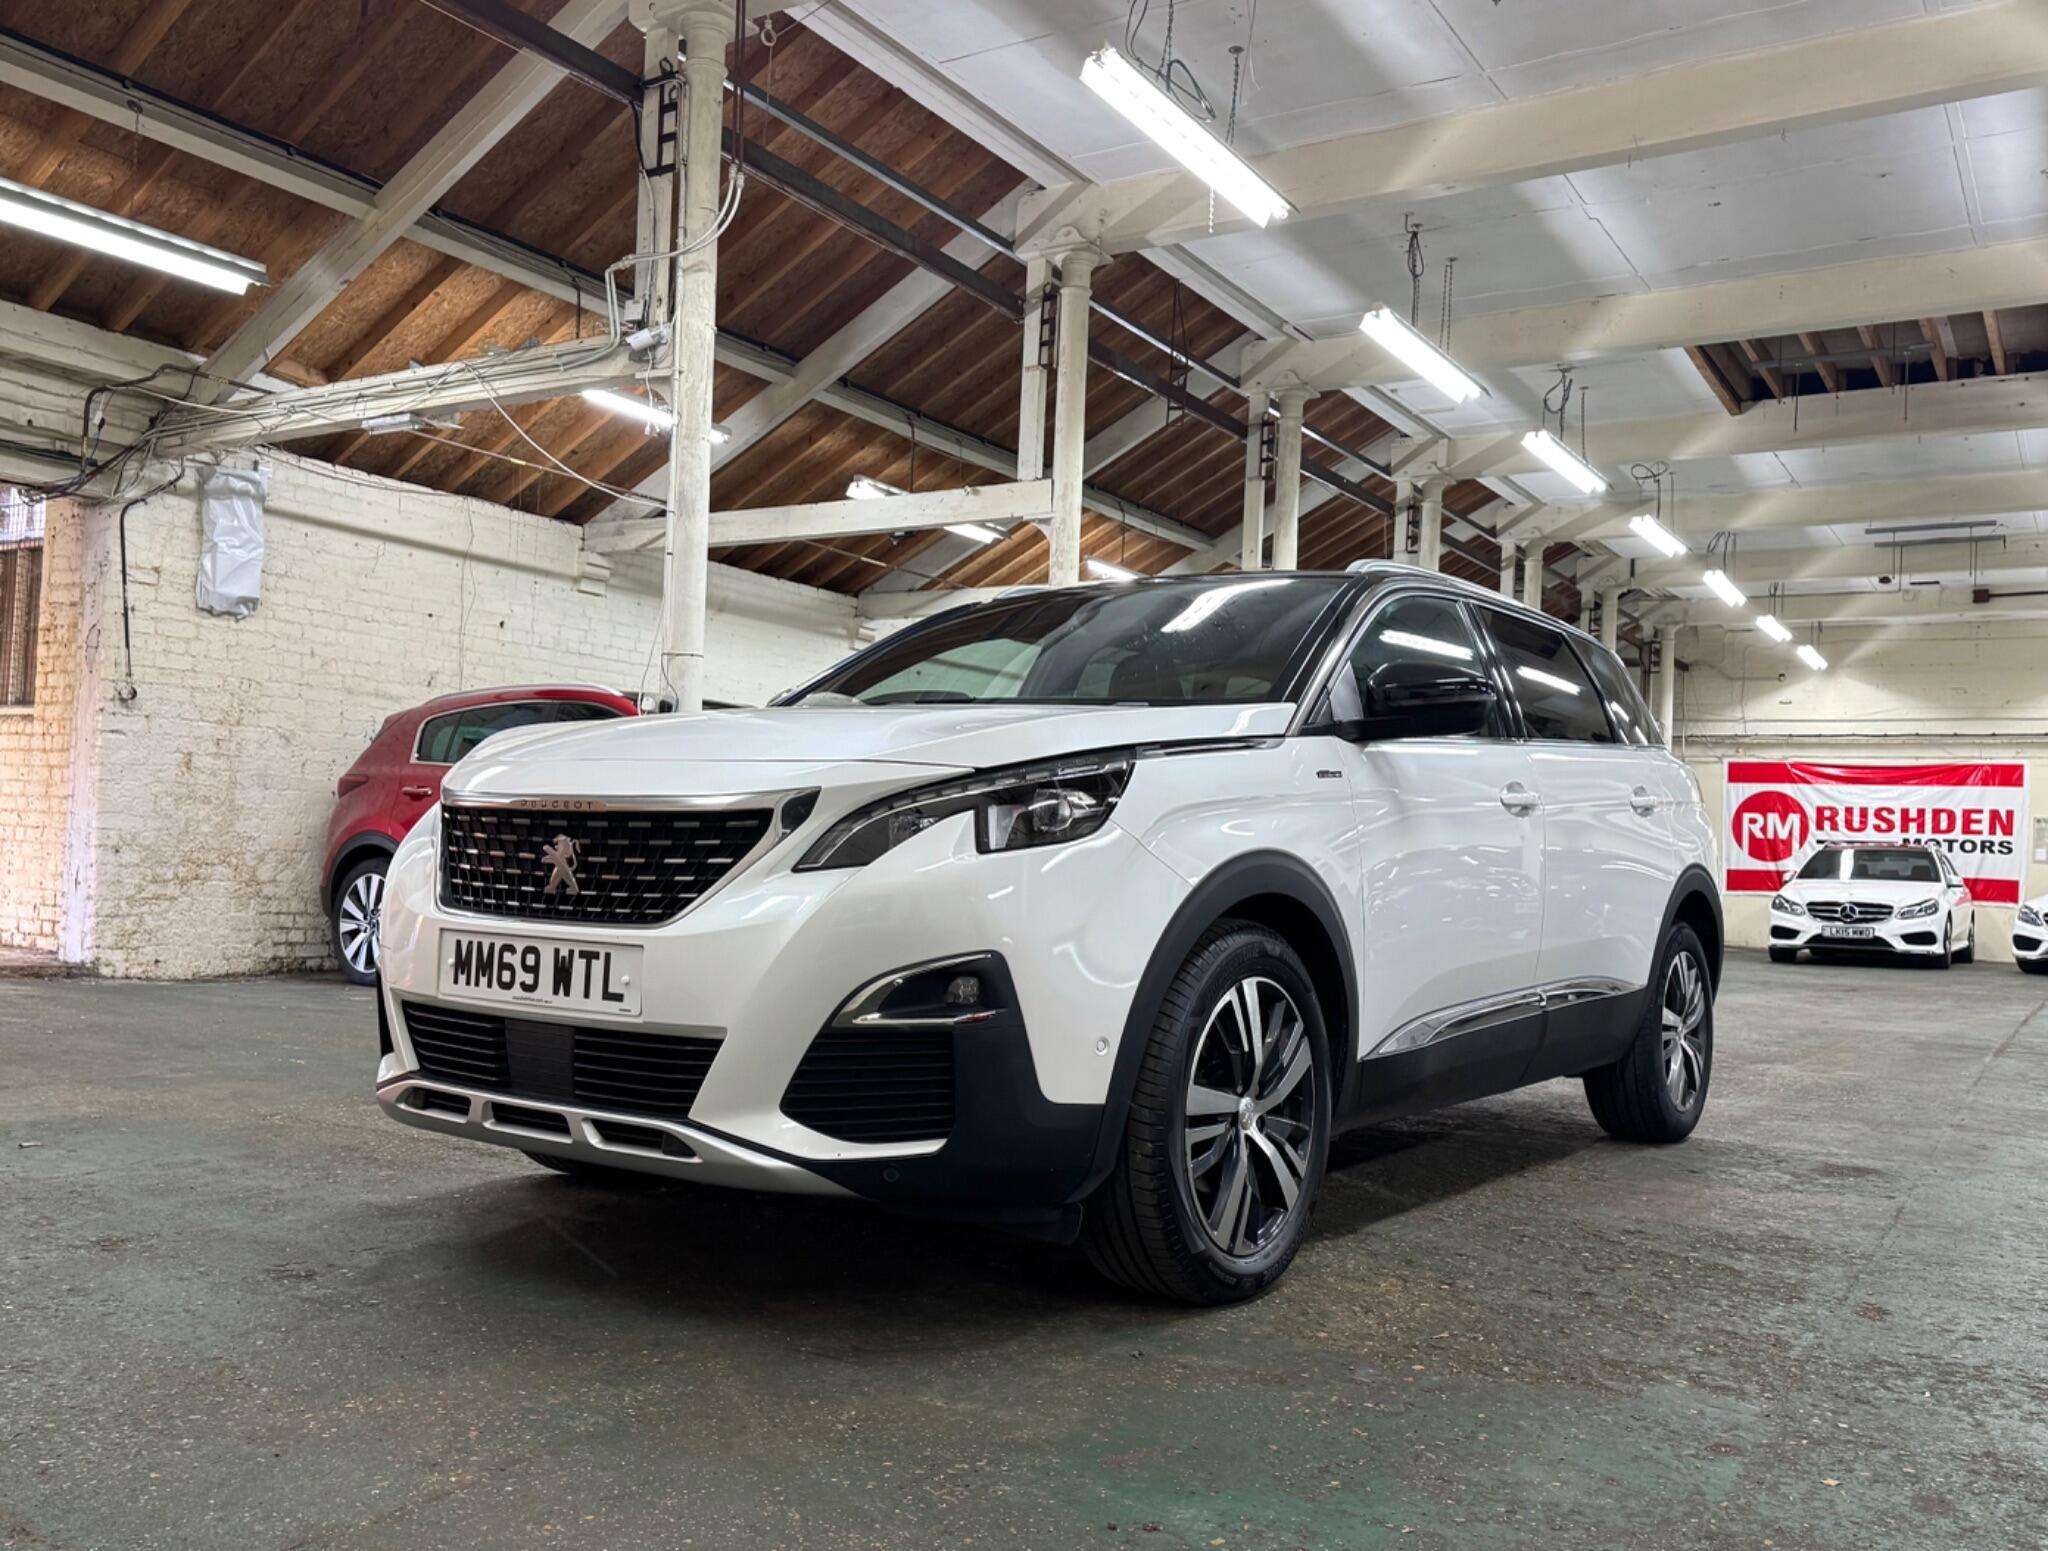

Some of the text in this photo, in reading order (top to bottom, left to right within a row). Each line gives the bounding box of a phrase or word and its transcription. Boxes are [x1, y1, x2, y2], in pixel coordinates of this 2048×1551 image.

[1742, 812, 1799, 855] RM
[1815, 805, 2014, 836] RUSHDEN
[453, 939, 624, 1002] MM69 WTL
